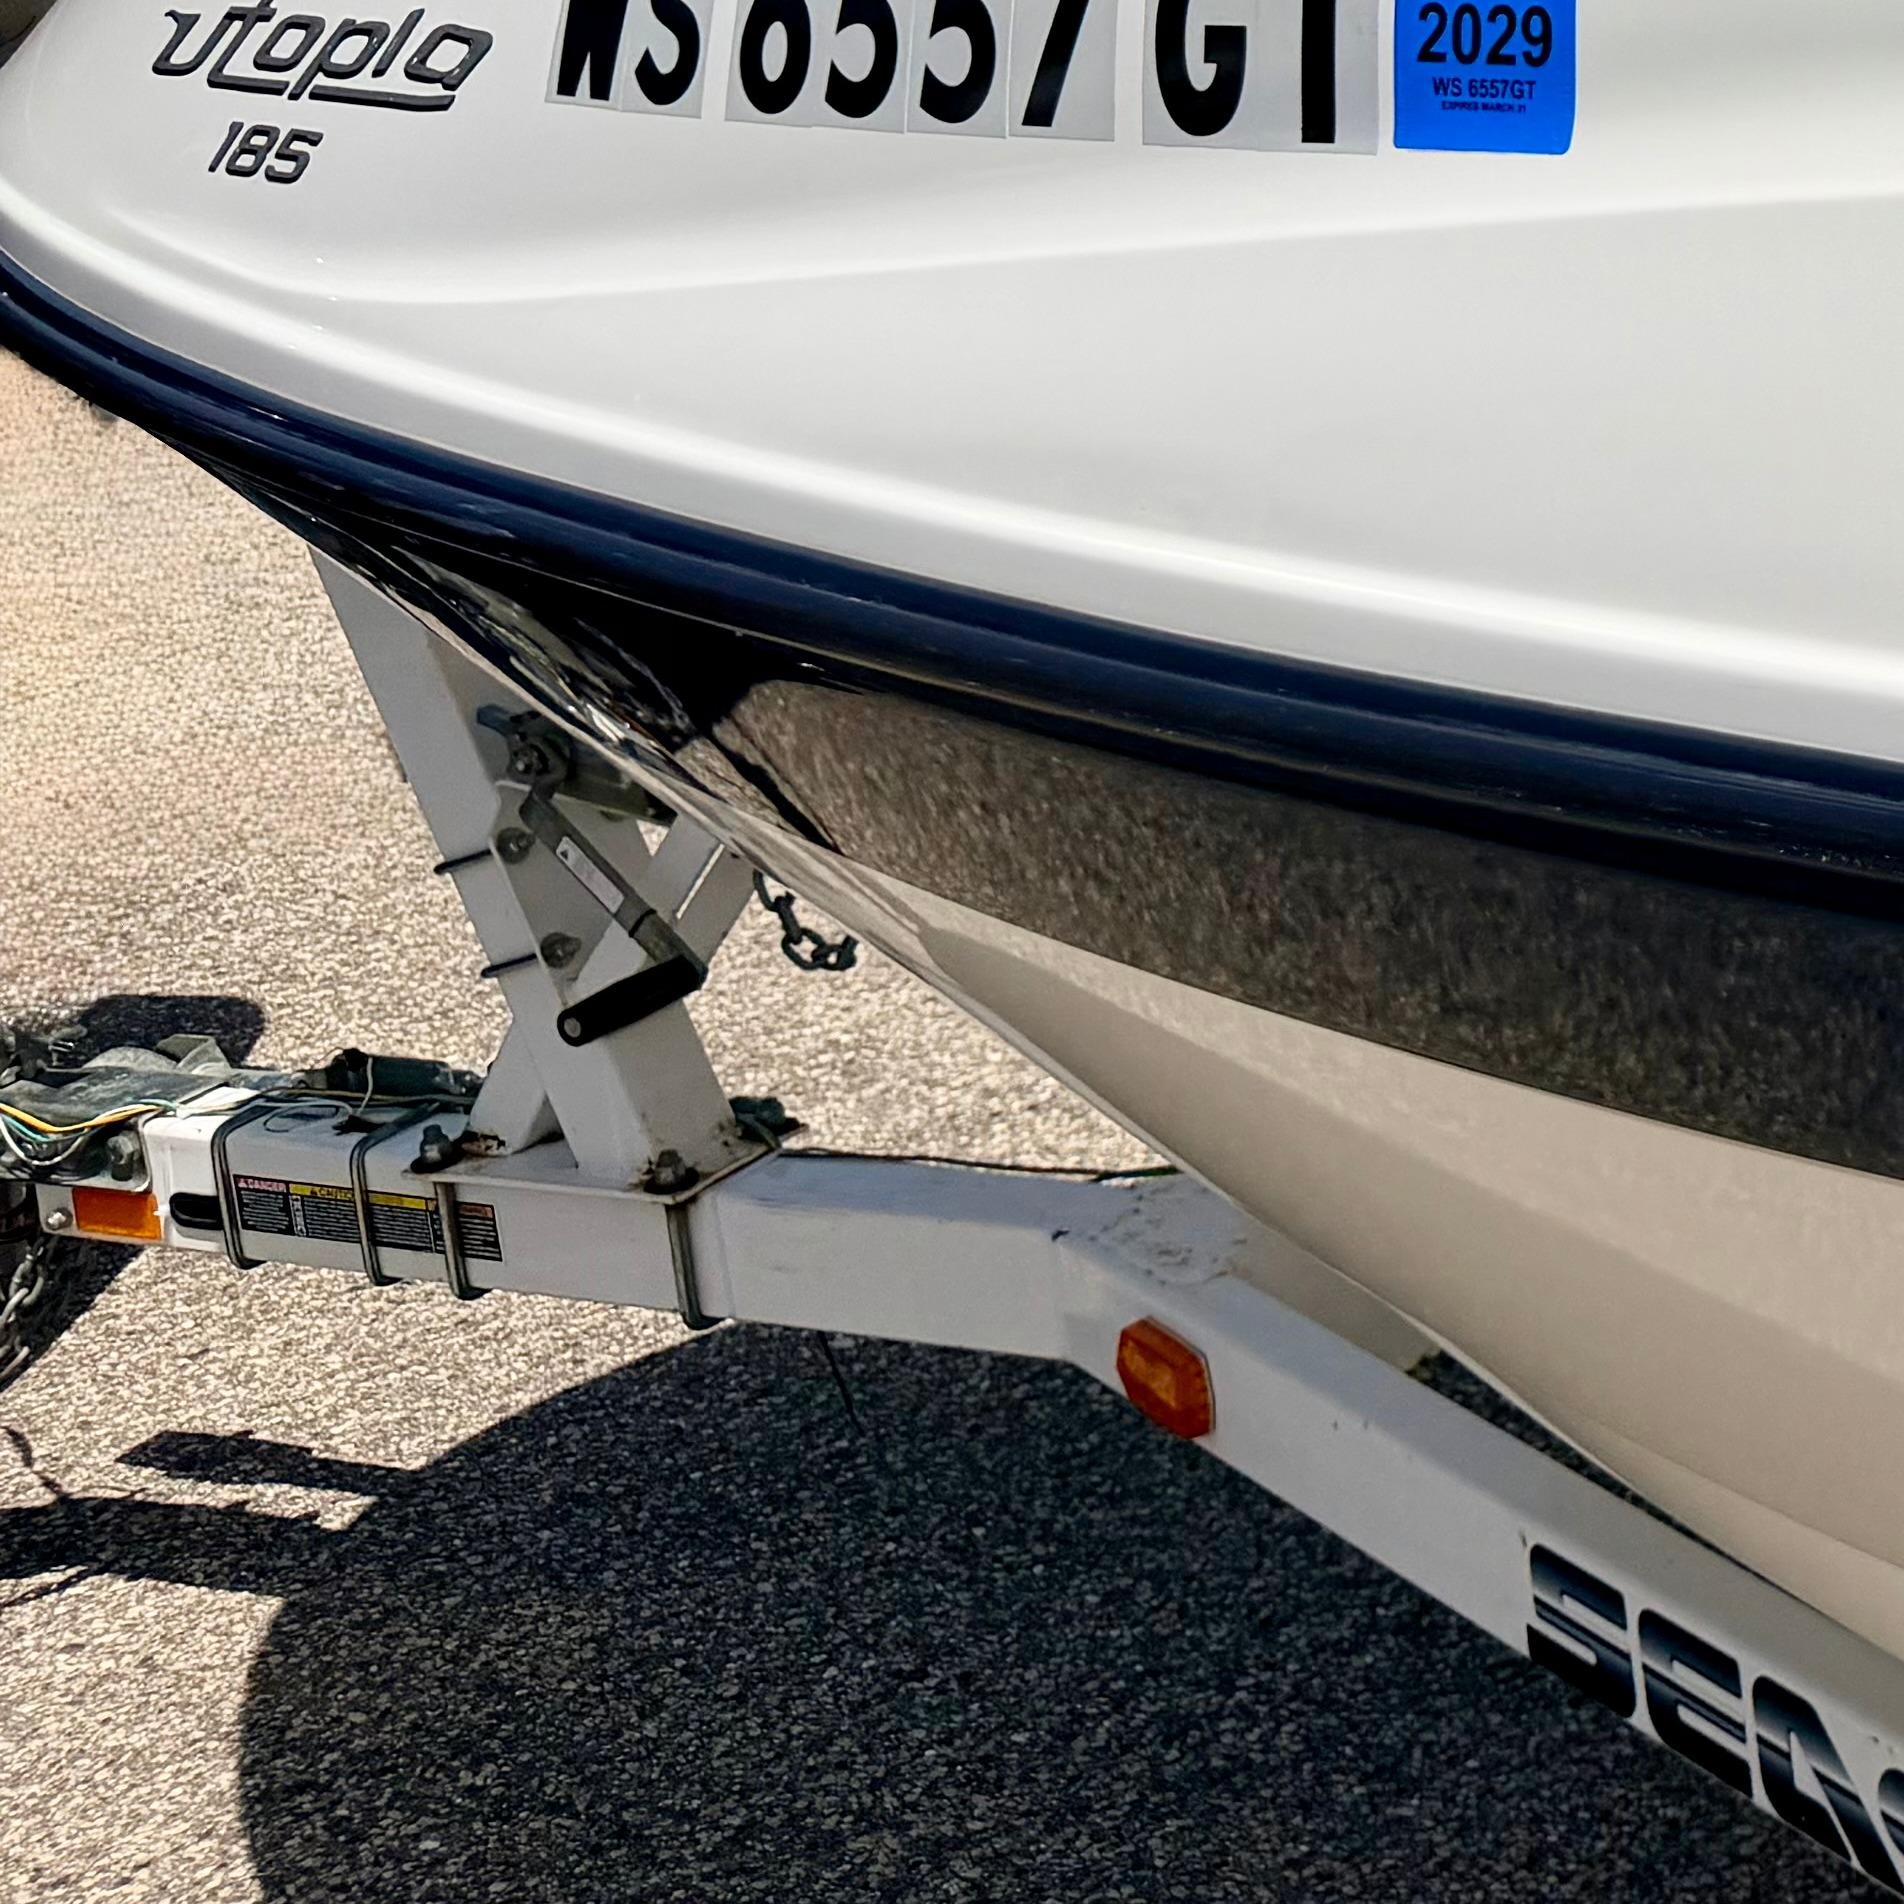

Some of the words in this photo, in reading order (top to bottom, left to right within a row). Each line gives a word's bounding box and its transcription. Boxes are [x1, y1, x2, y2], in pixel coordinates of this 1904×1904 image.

[1416, 1, 1553, 68] 2029
[1432, 76, 1463, 97] WS
[1467, 78, 1537, 100] 6557GT
[207, 121, 323, 184] 185
